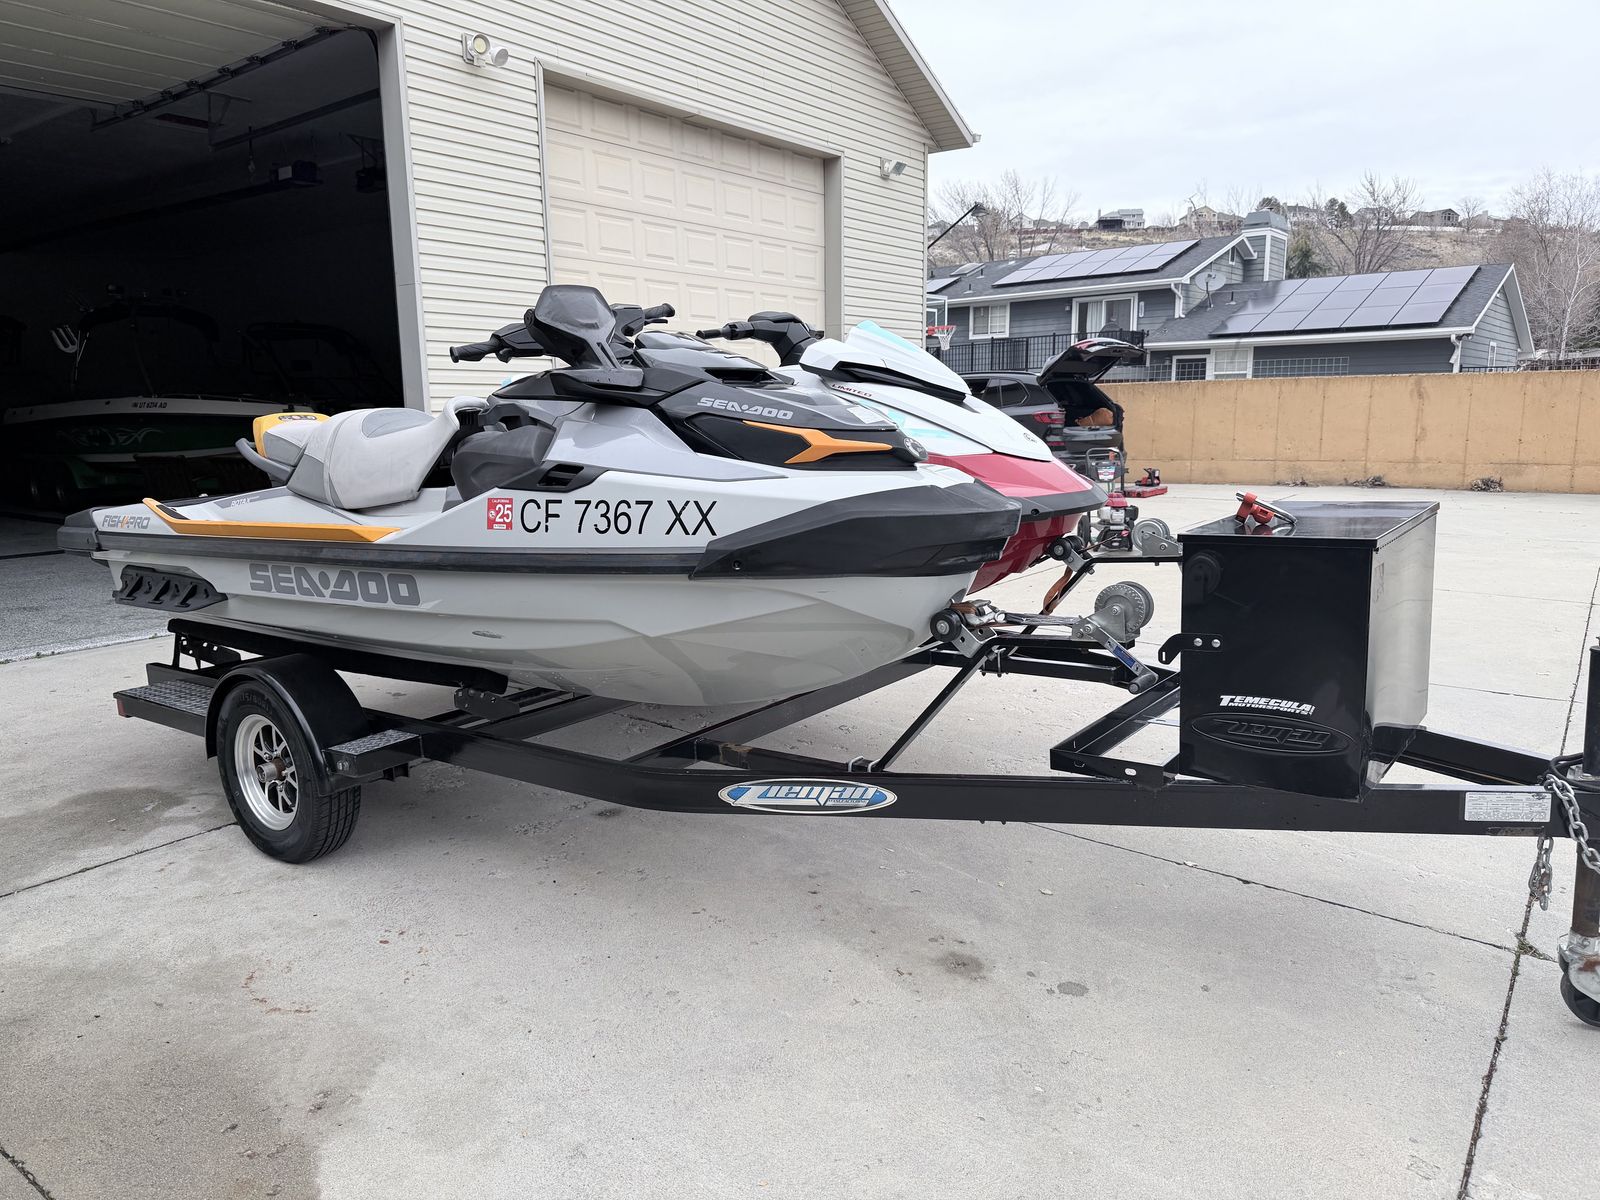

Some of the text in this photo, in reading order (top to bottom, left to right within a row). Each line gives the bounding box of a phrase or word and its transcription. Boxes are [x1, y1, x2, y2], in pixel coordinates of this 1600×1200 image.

[831, 383, 872, 397] LIMITED
[495, 504, 512, 522] 25
[520, 498, 717, 536] CF 7367 XX
[1229, 702, 1309, 715] MOTORSPORTS
